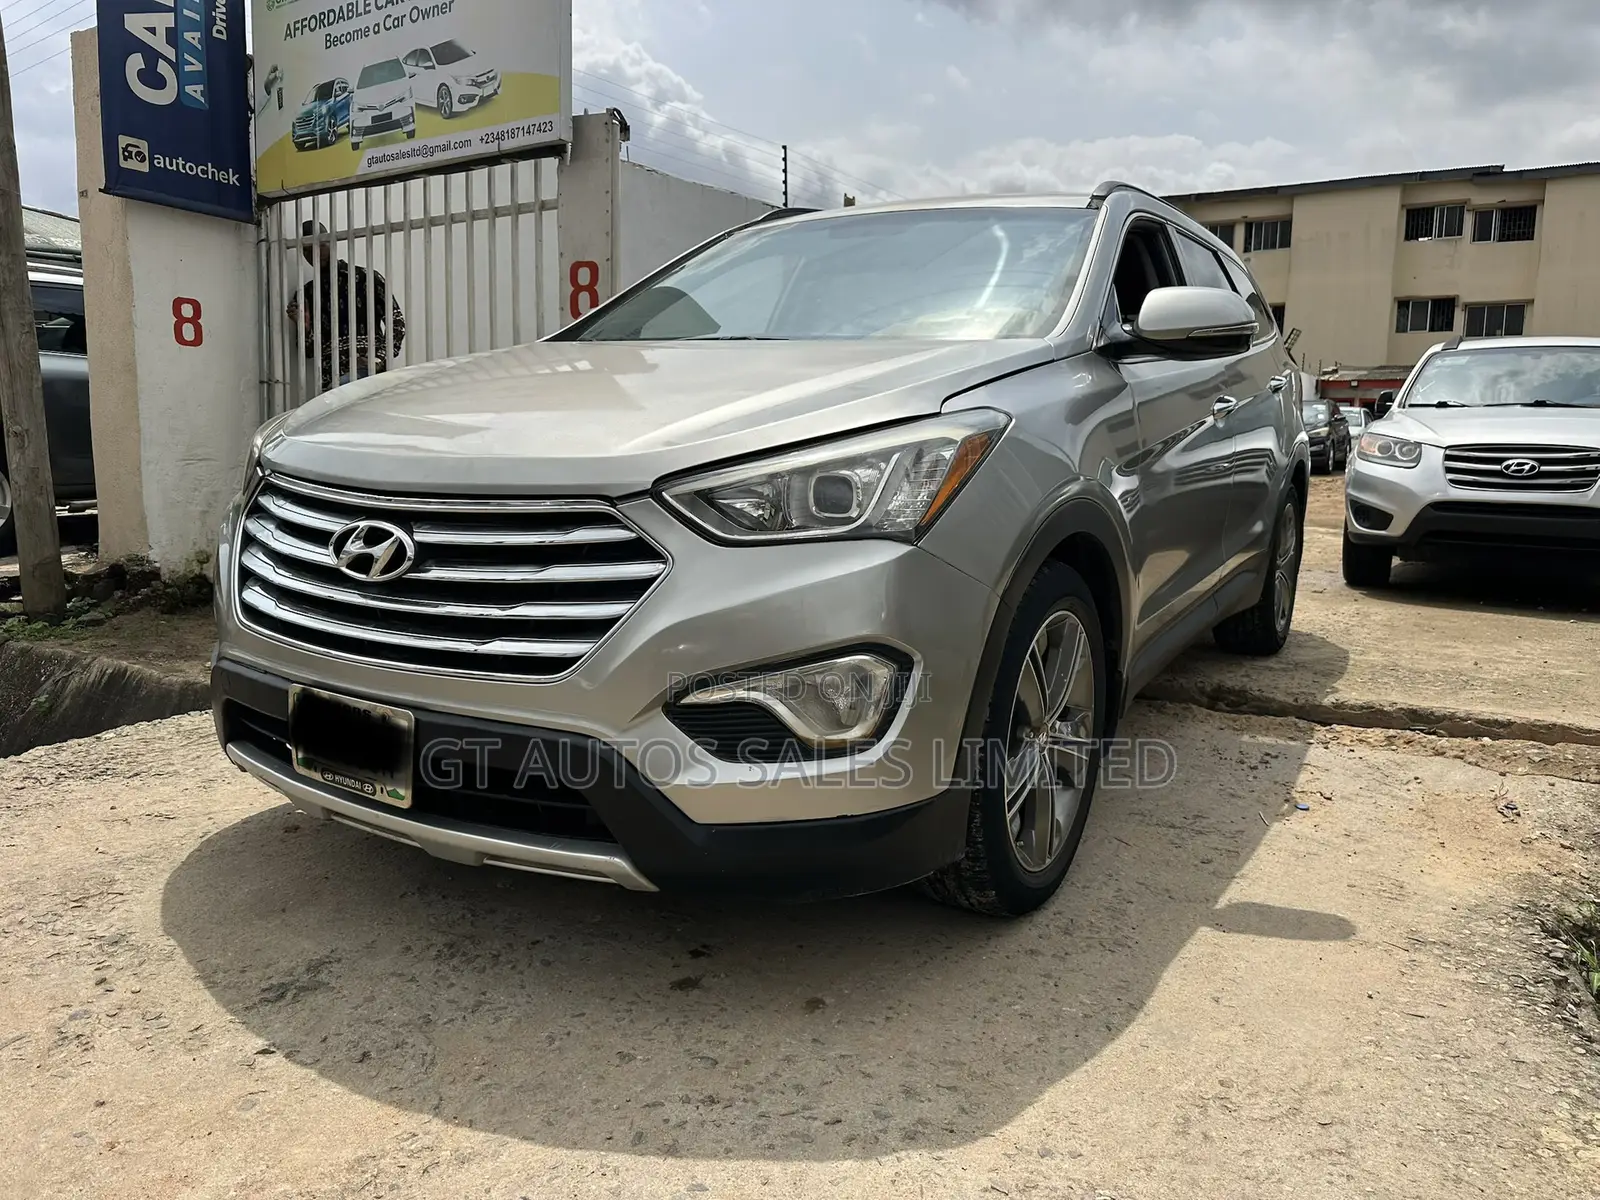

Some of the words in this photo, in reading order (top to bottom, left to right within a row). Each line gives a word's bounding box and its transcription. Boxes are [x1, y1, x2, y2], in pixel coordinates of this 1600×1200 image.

[284, 0, 372, 41] AFFORDABLE
[324, 25, 370, 50] Become
[372, 22, 381, 35] a
[383, 13, 407, 31] Car
[409, 0, 455, 24] Owner
[124, 0, 179, 106] CA
[183, 0, 205, 104] AVAI
[367, 138, 472, 167] gtautosalesltd@gmail.com
[479, 120, 554, 145] +2348187147423
[153, 154, 241, 187] autochek
[569, 260, 599, 321] 8
[172, 296, 203, 347] 8
[334, 774, 362, 789] HYUNDAI
